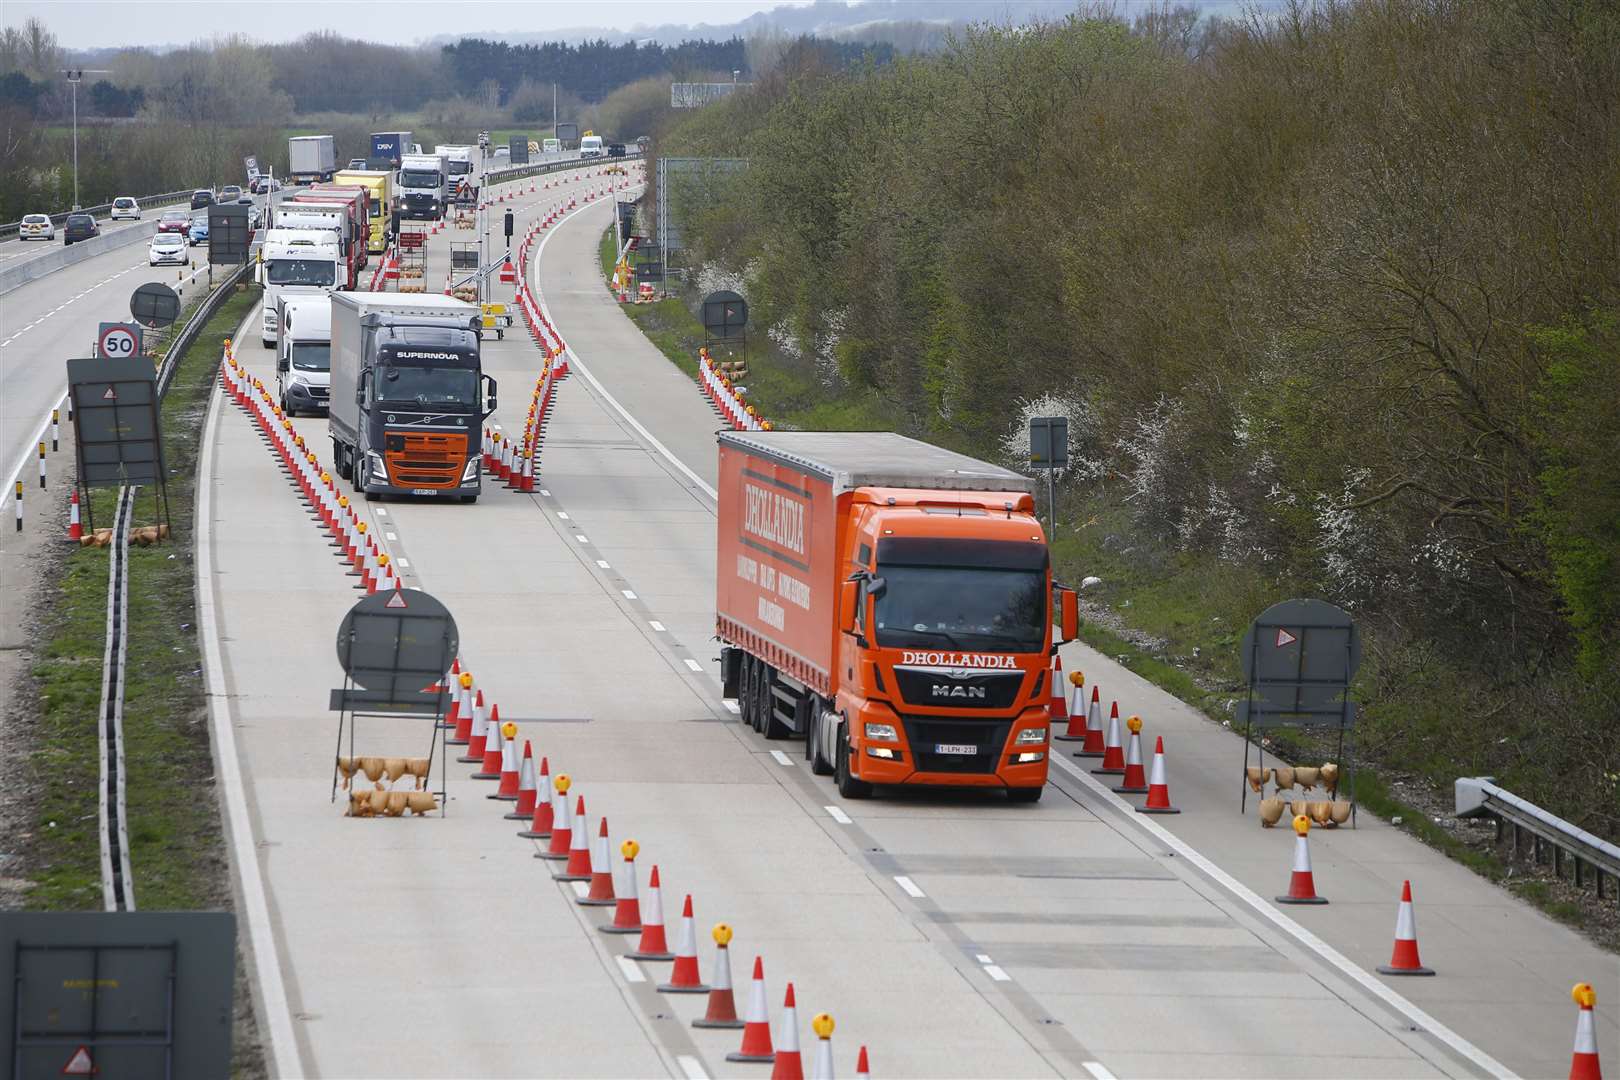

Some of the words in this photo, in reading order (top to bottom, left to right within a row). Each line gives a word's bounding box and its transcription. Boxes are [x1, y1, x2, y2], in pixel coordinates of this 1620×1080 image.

[107, 337, 132, 353] 50
[396, 351, 459, 361] SUPERNOVA
[745, 484, 804, 554] DHOLLANDIA
[902, 651, 1017, 669] DHOLLANDIA
[932, 684, 985, 698] MAN
